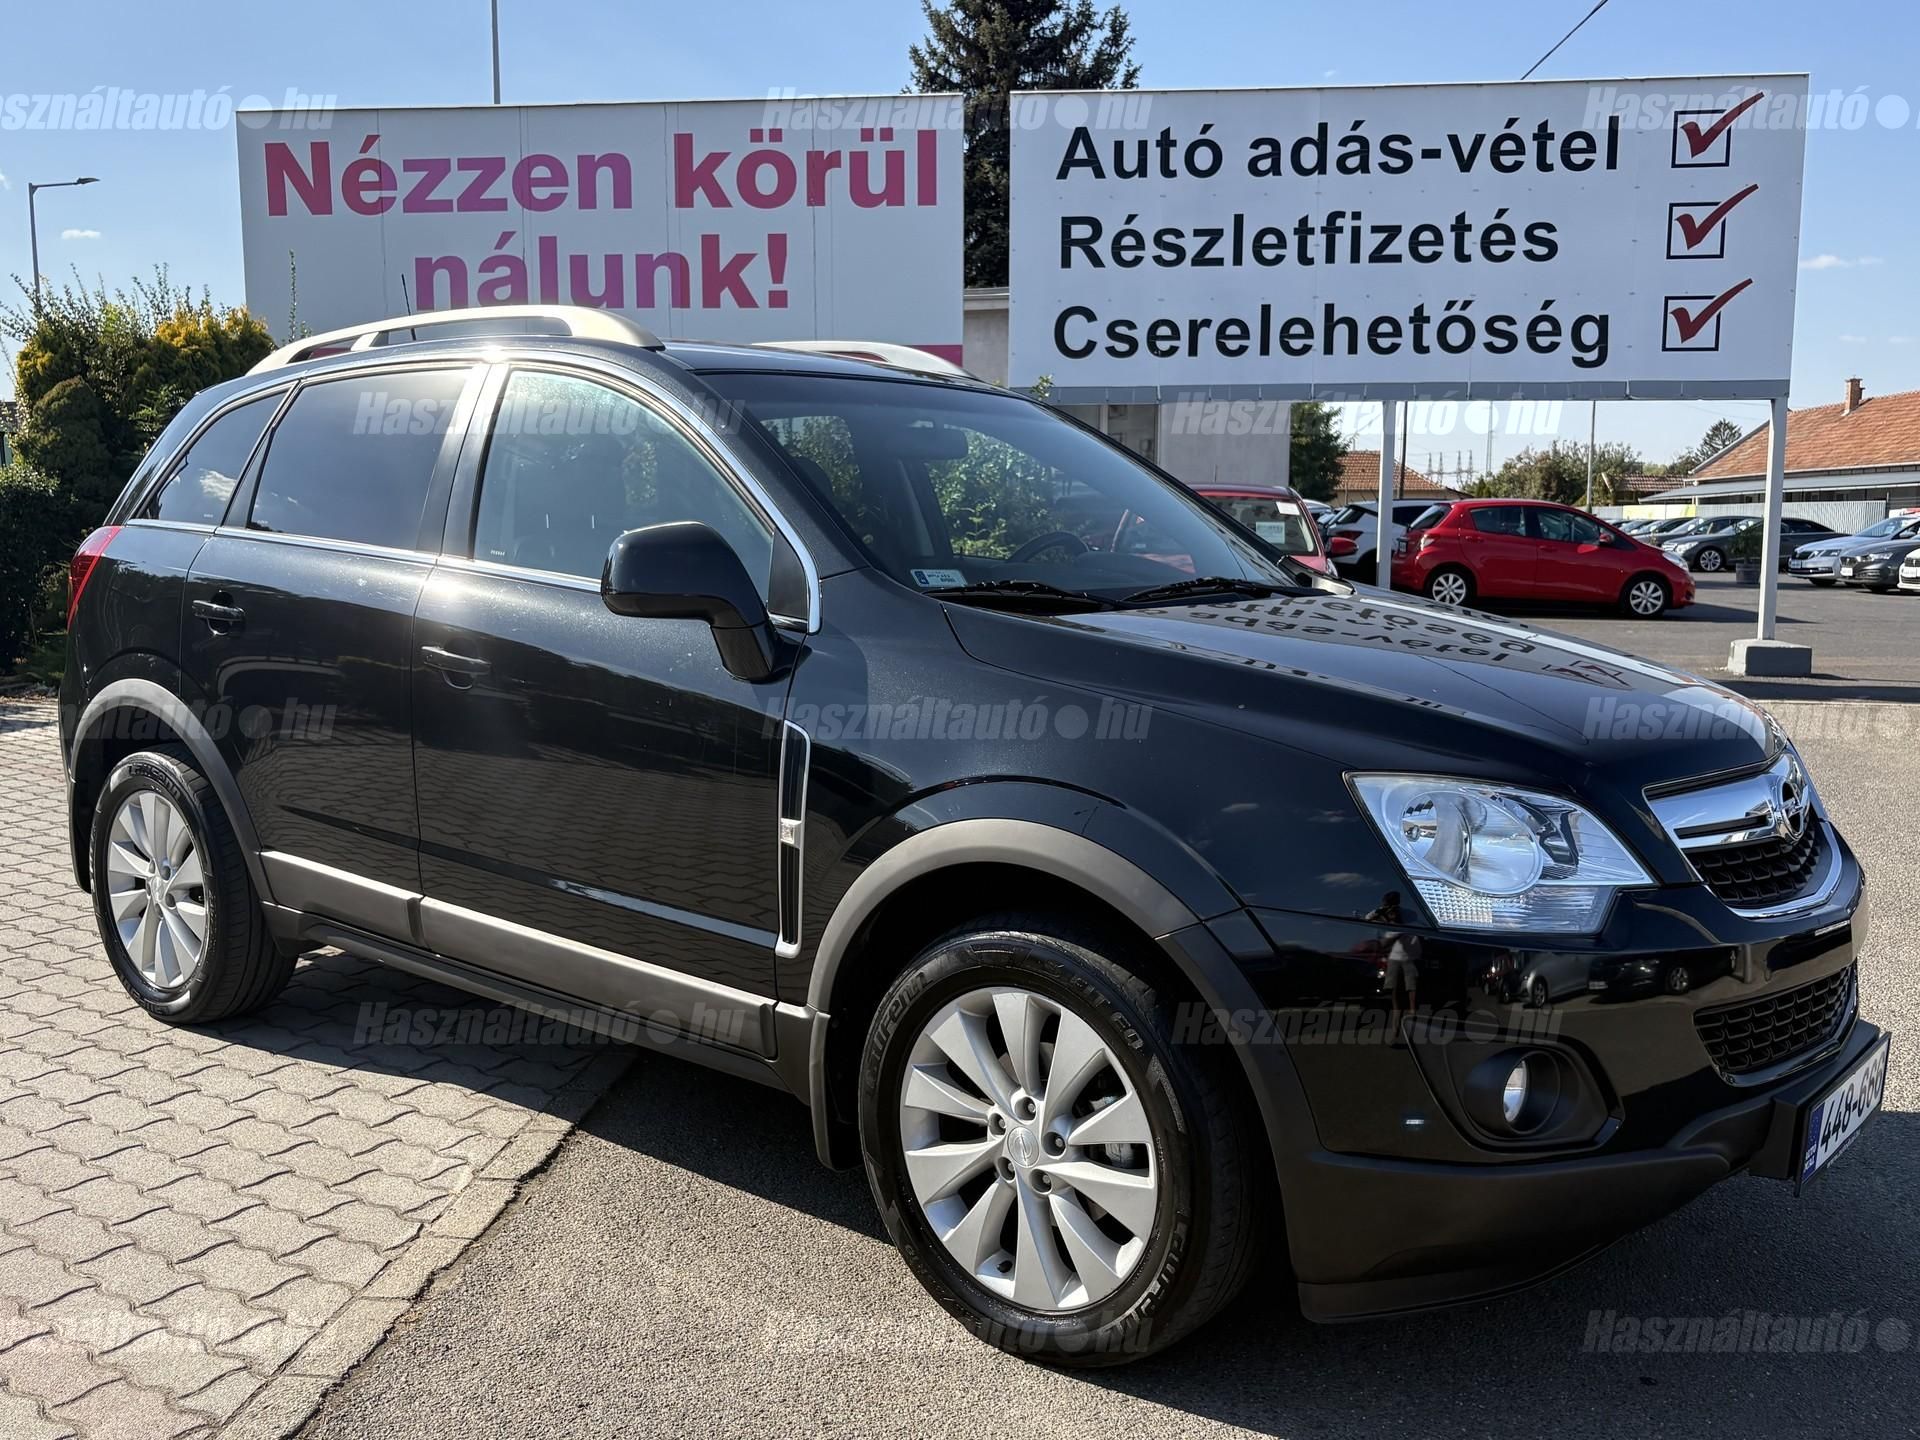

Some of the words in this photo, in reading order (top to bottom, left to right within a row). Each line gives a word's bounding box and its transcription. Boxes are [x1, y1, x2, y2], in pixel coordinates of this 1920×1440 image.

[265, 135, 632, 216] Nézzen
[675, 128, 938, 209] körül
[1056, 124, 1223, 180] Autó
[1248, 116, 1620, 177] adás-vétel
[416, 232, 788, 309] nálunk!
[1061, 208, 1559, 269] Részletfizetés
[1054, 300, 1610, 368] Cserelehetőség
